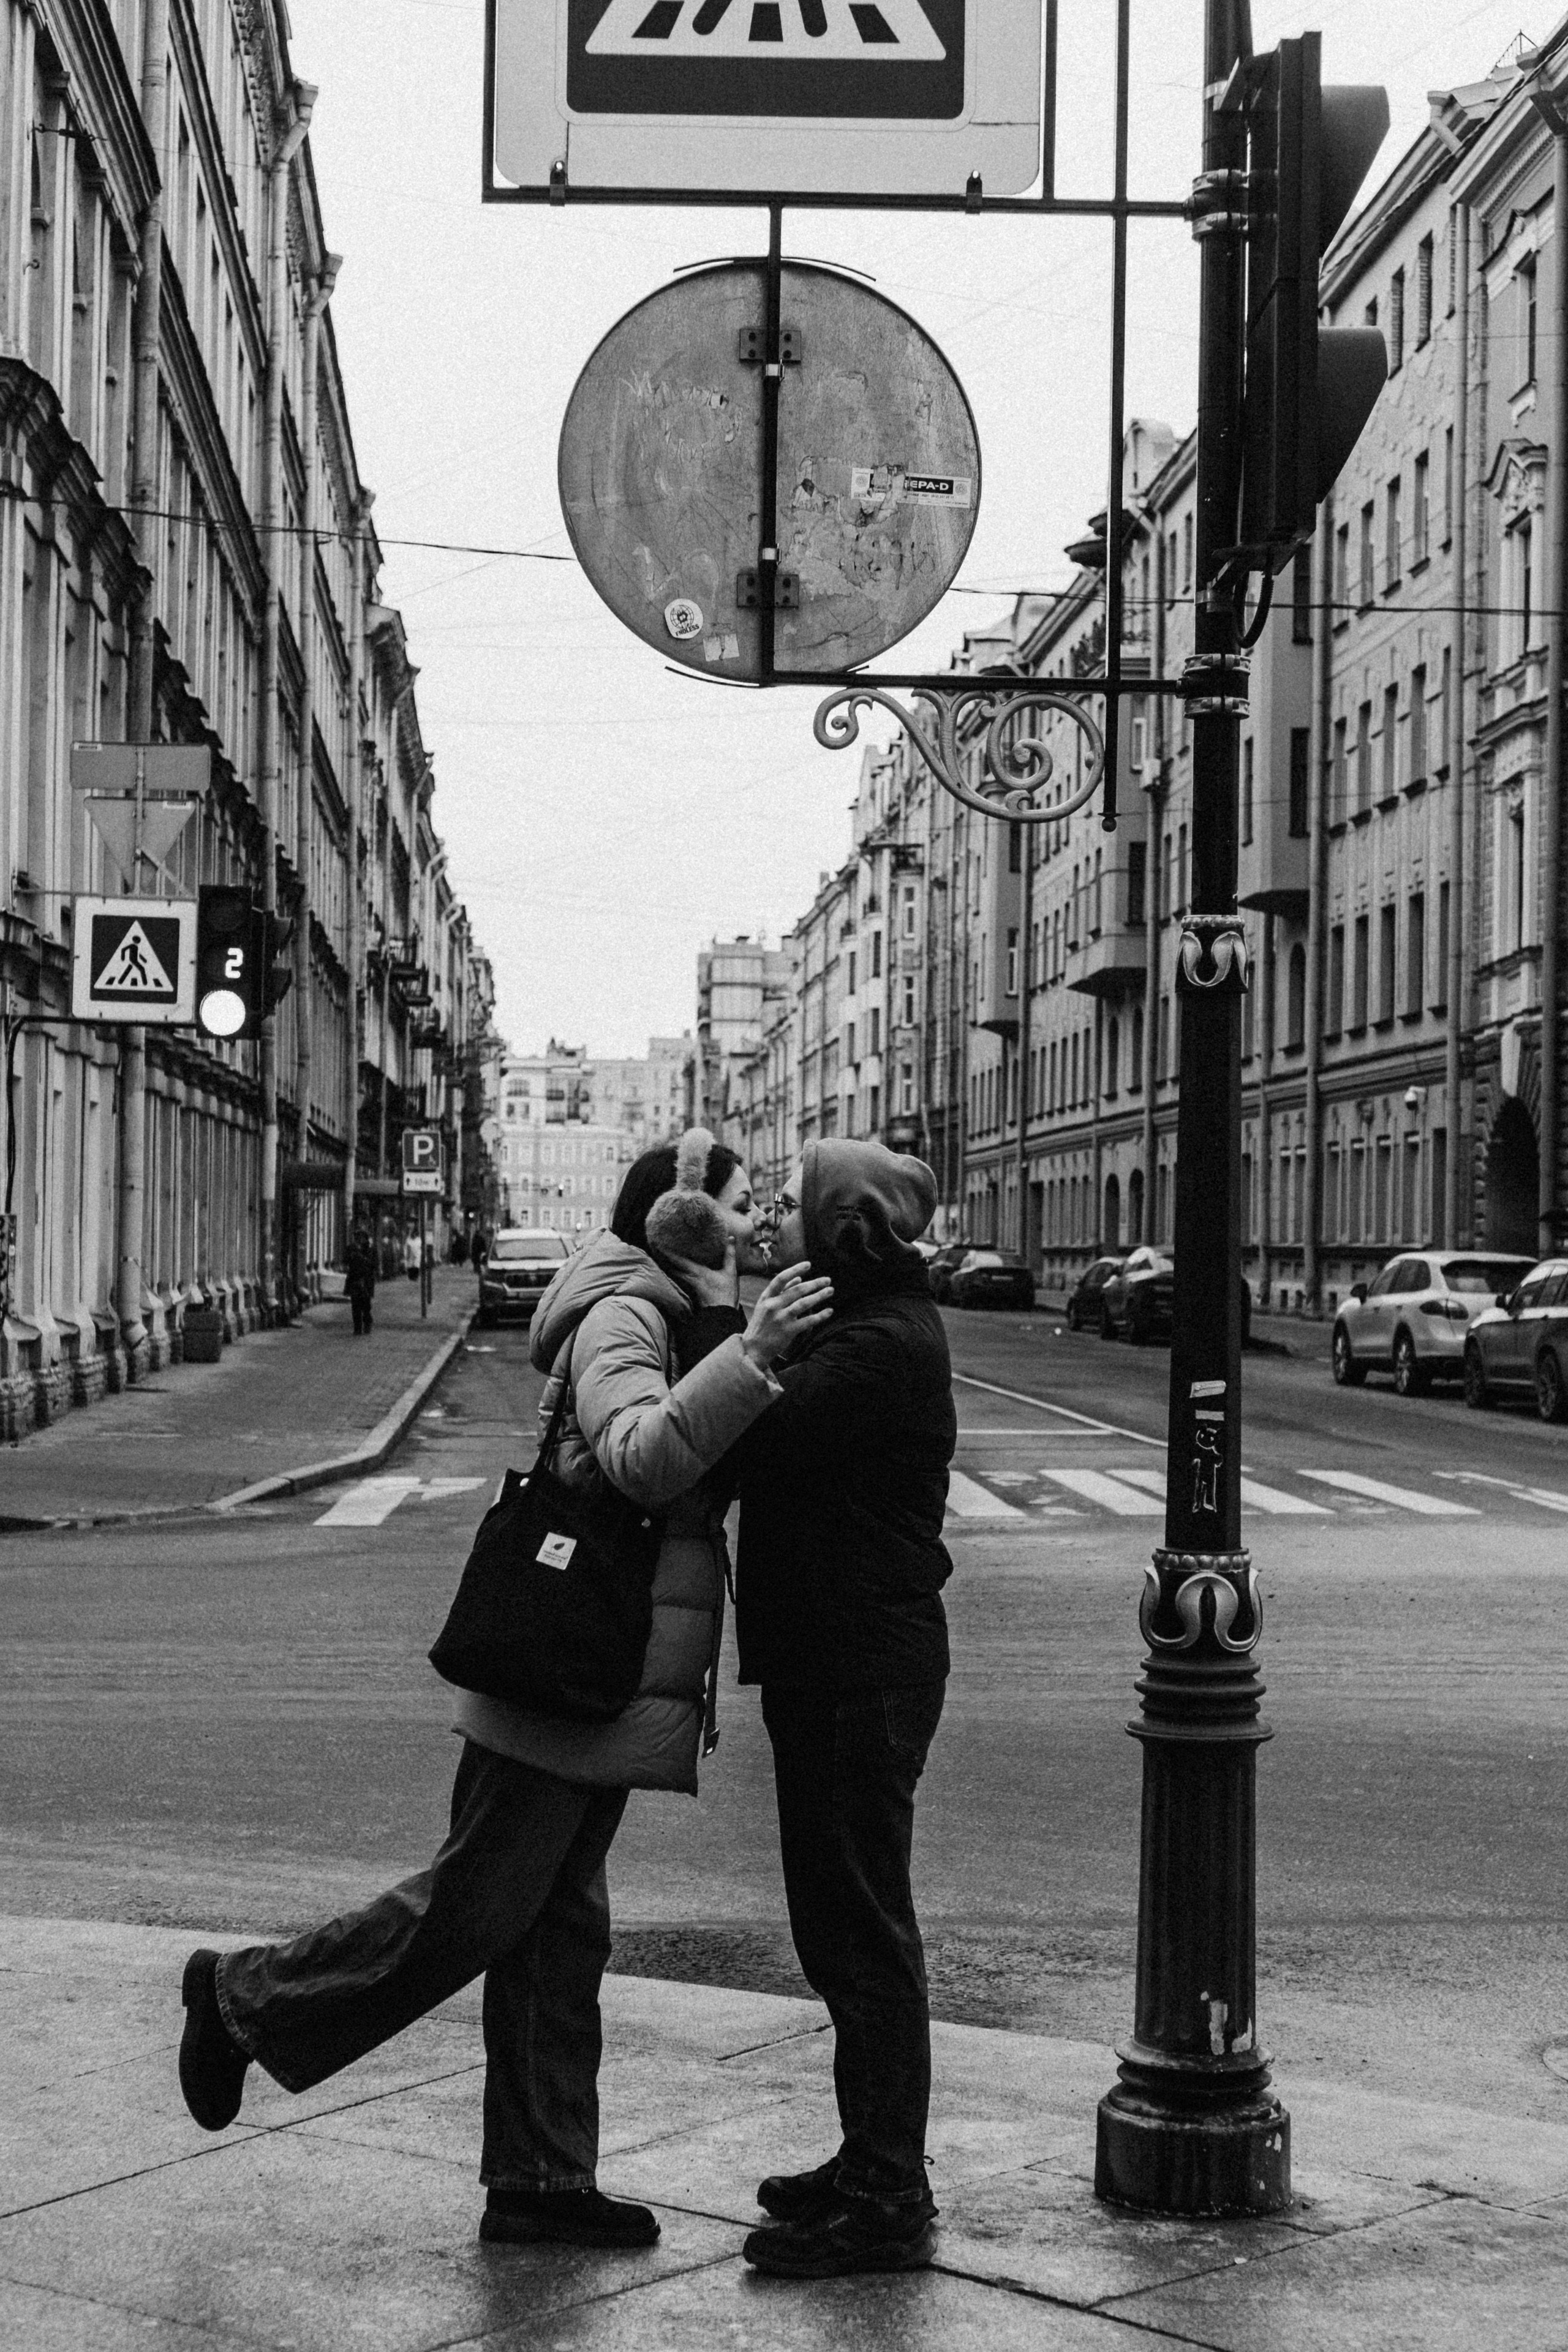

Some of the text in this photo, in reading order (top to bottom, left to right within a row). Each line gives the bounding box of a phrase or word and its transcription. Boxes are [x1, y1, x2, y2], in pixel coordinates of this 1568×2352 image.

[676, 624, 699, 636] ENDLESS
[225, 948, 243, 979] 2
[413, 1135, 434, 1164] P
